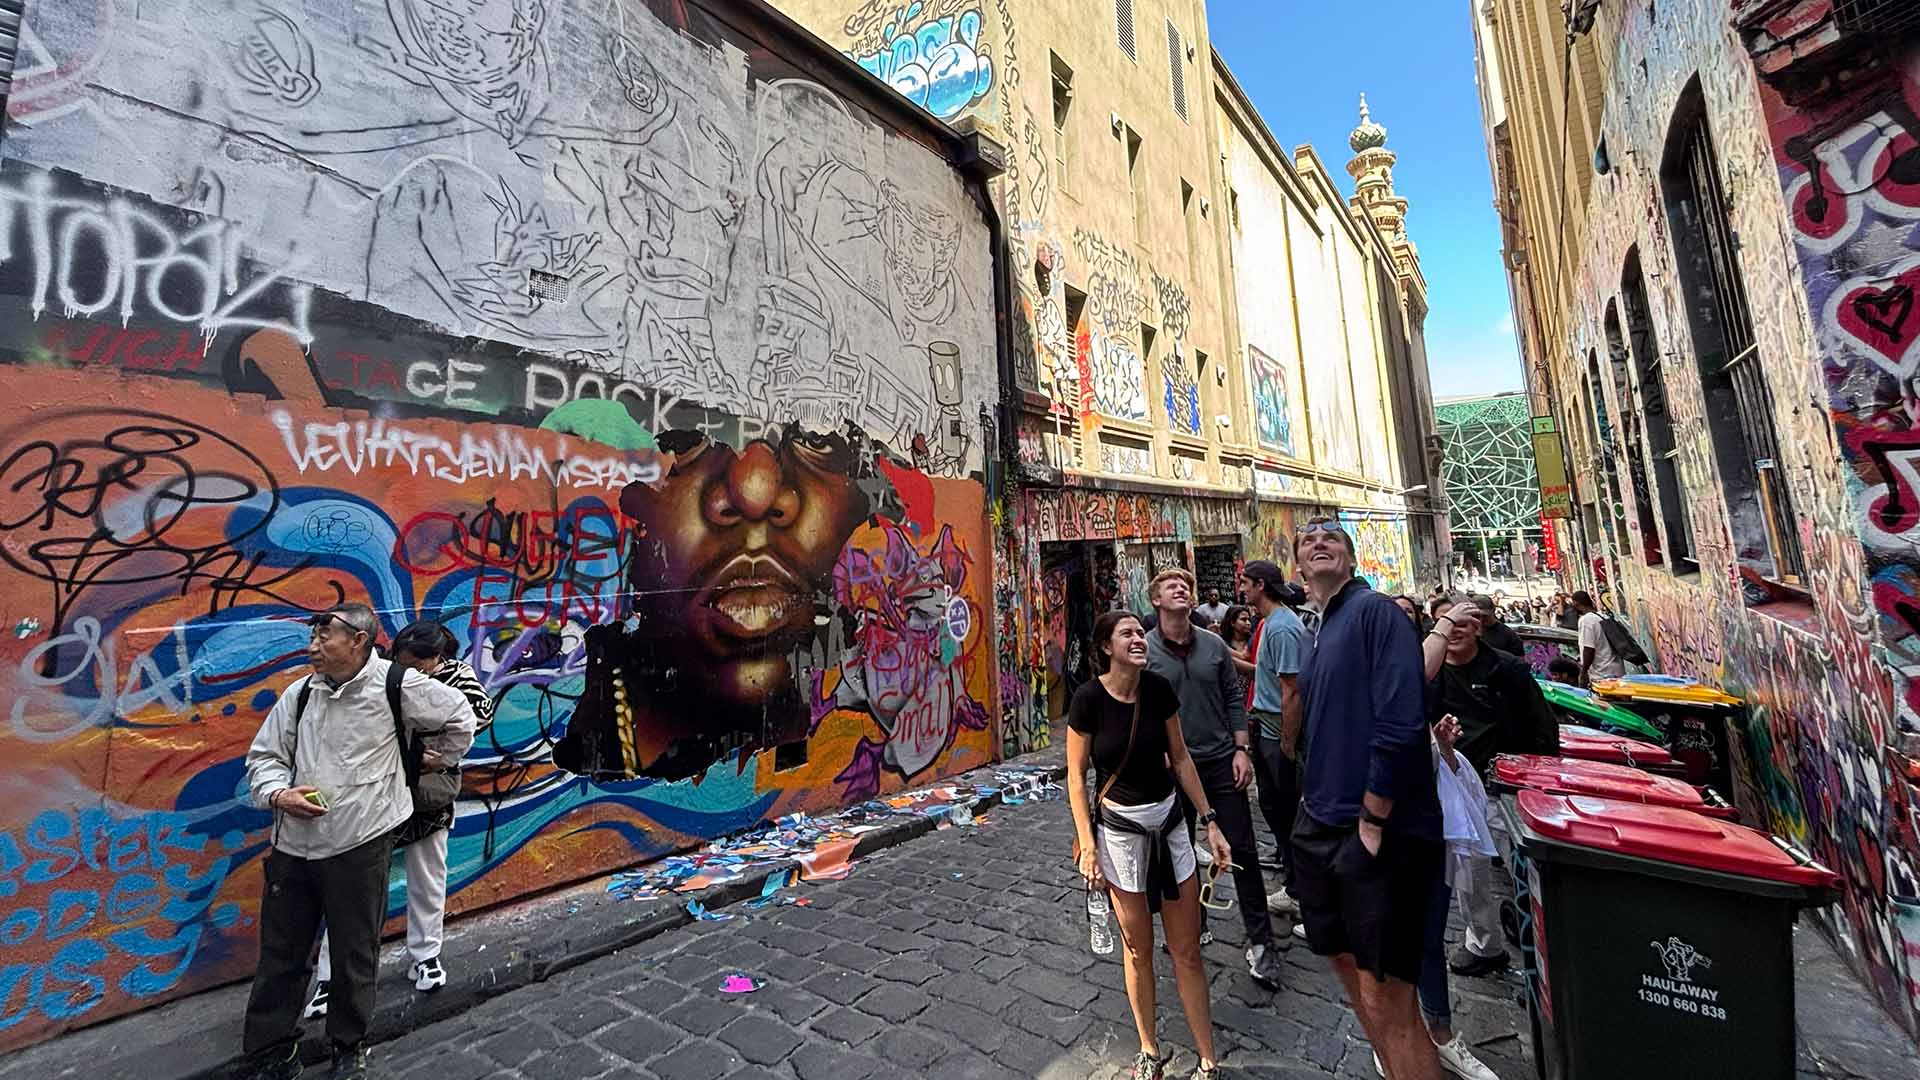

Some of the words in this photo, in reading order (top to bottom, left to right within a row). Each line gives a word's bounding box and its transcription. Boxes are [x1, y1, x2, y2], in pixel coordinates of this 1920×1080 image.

[1642, 974, 1719, 1001] HAULAWAY
[1638, 989, 1669, 1006] 1300
[1673, 997, 1698, 1013] 660
[1701, 1004, 1726, 1020] 838
